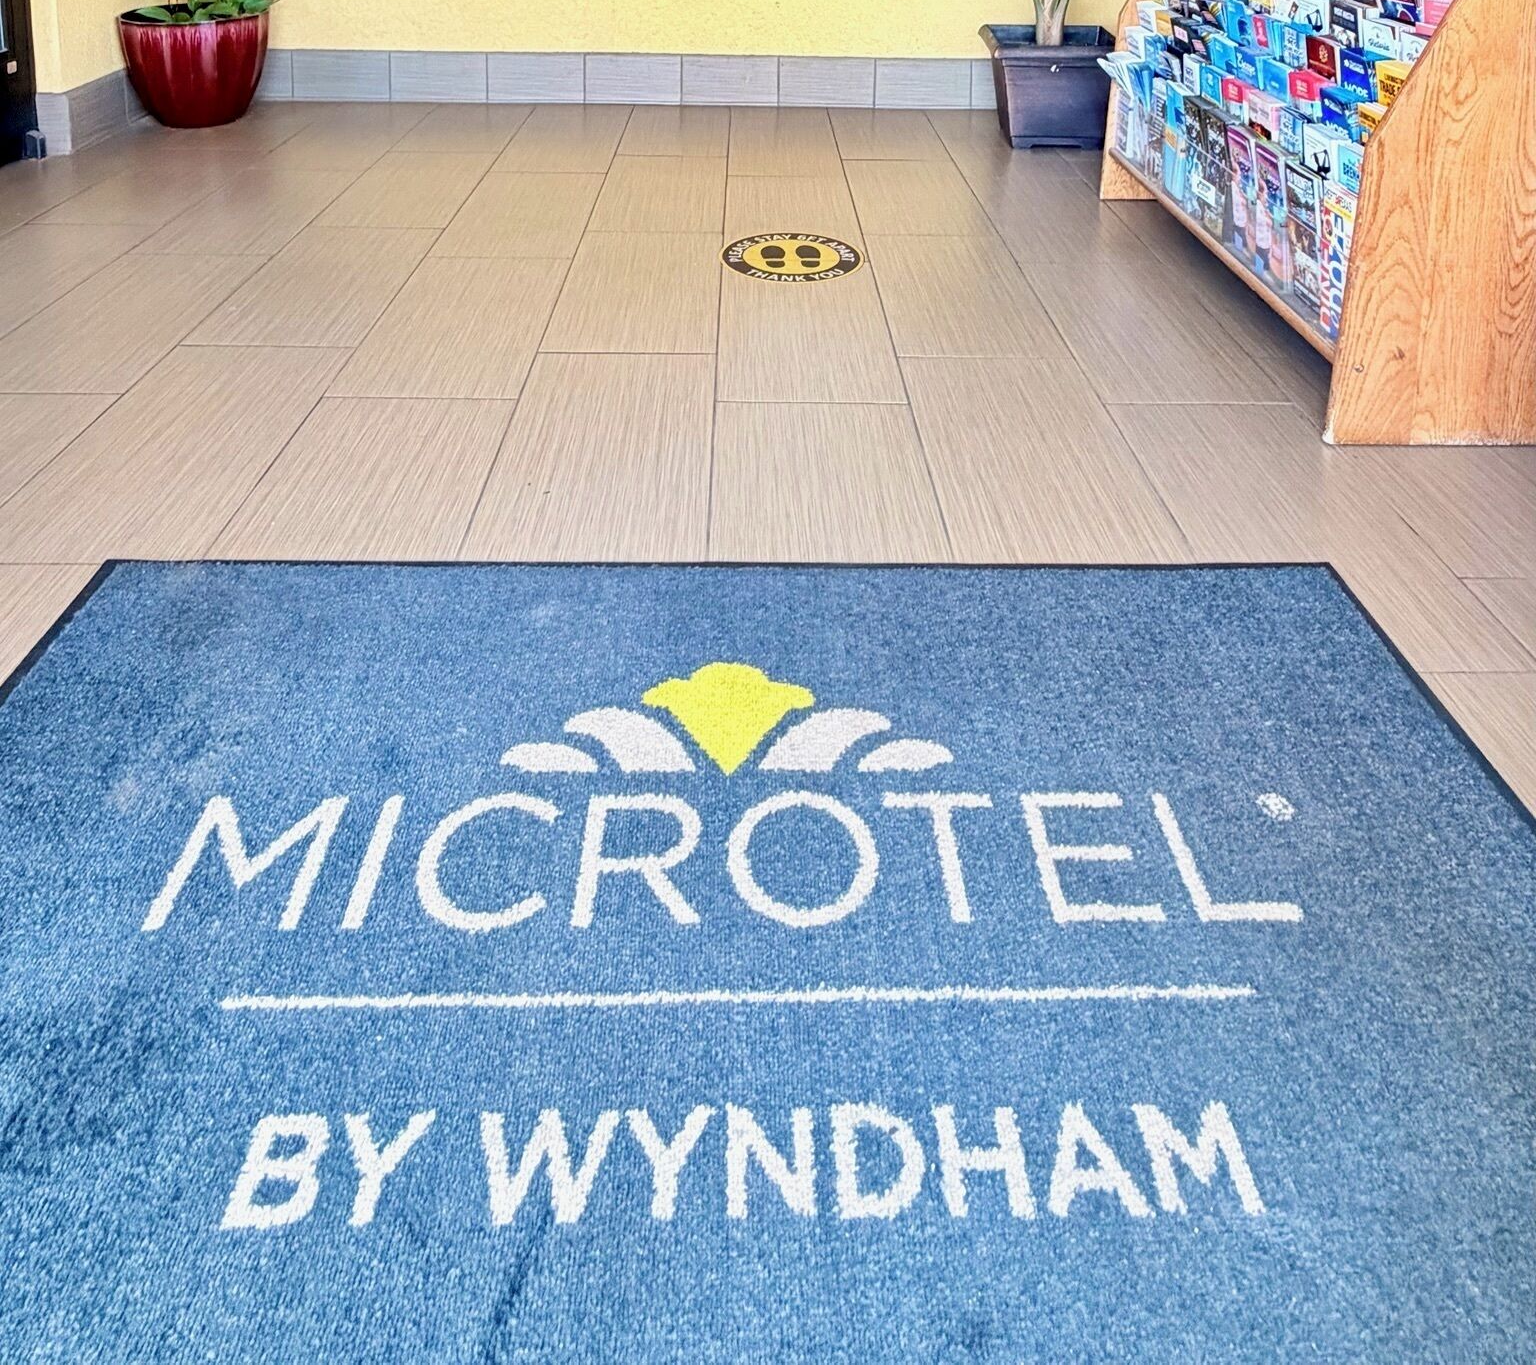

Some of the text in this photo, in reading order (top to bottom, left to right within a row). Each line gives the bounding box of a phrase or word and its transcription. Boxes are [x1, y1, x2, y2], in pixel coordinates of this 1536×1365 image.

[728, 234, 855, 263] PLEASE STAY 6FT APART
[746, 268, 844, 282] THANK YOU
[219, 1099, 1266, 1231] BY WYNDHAM
